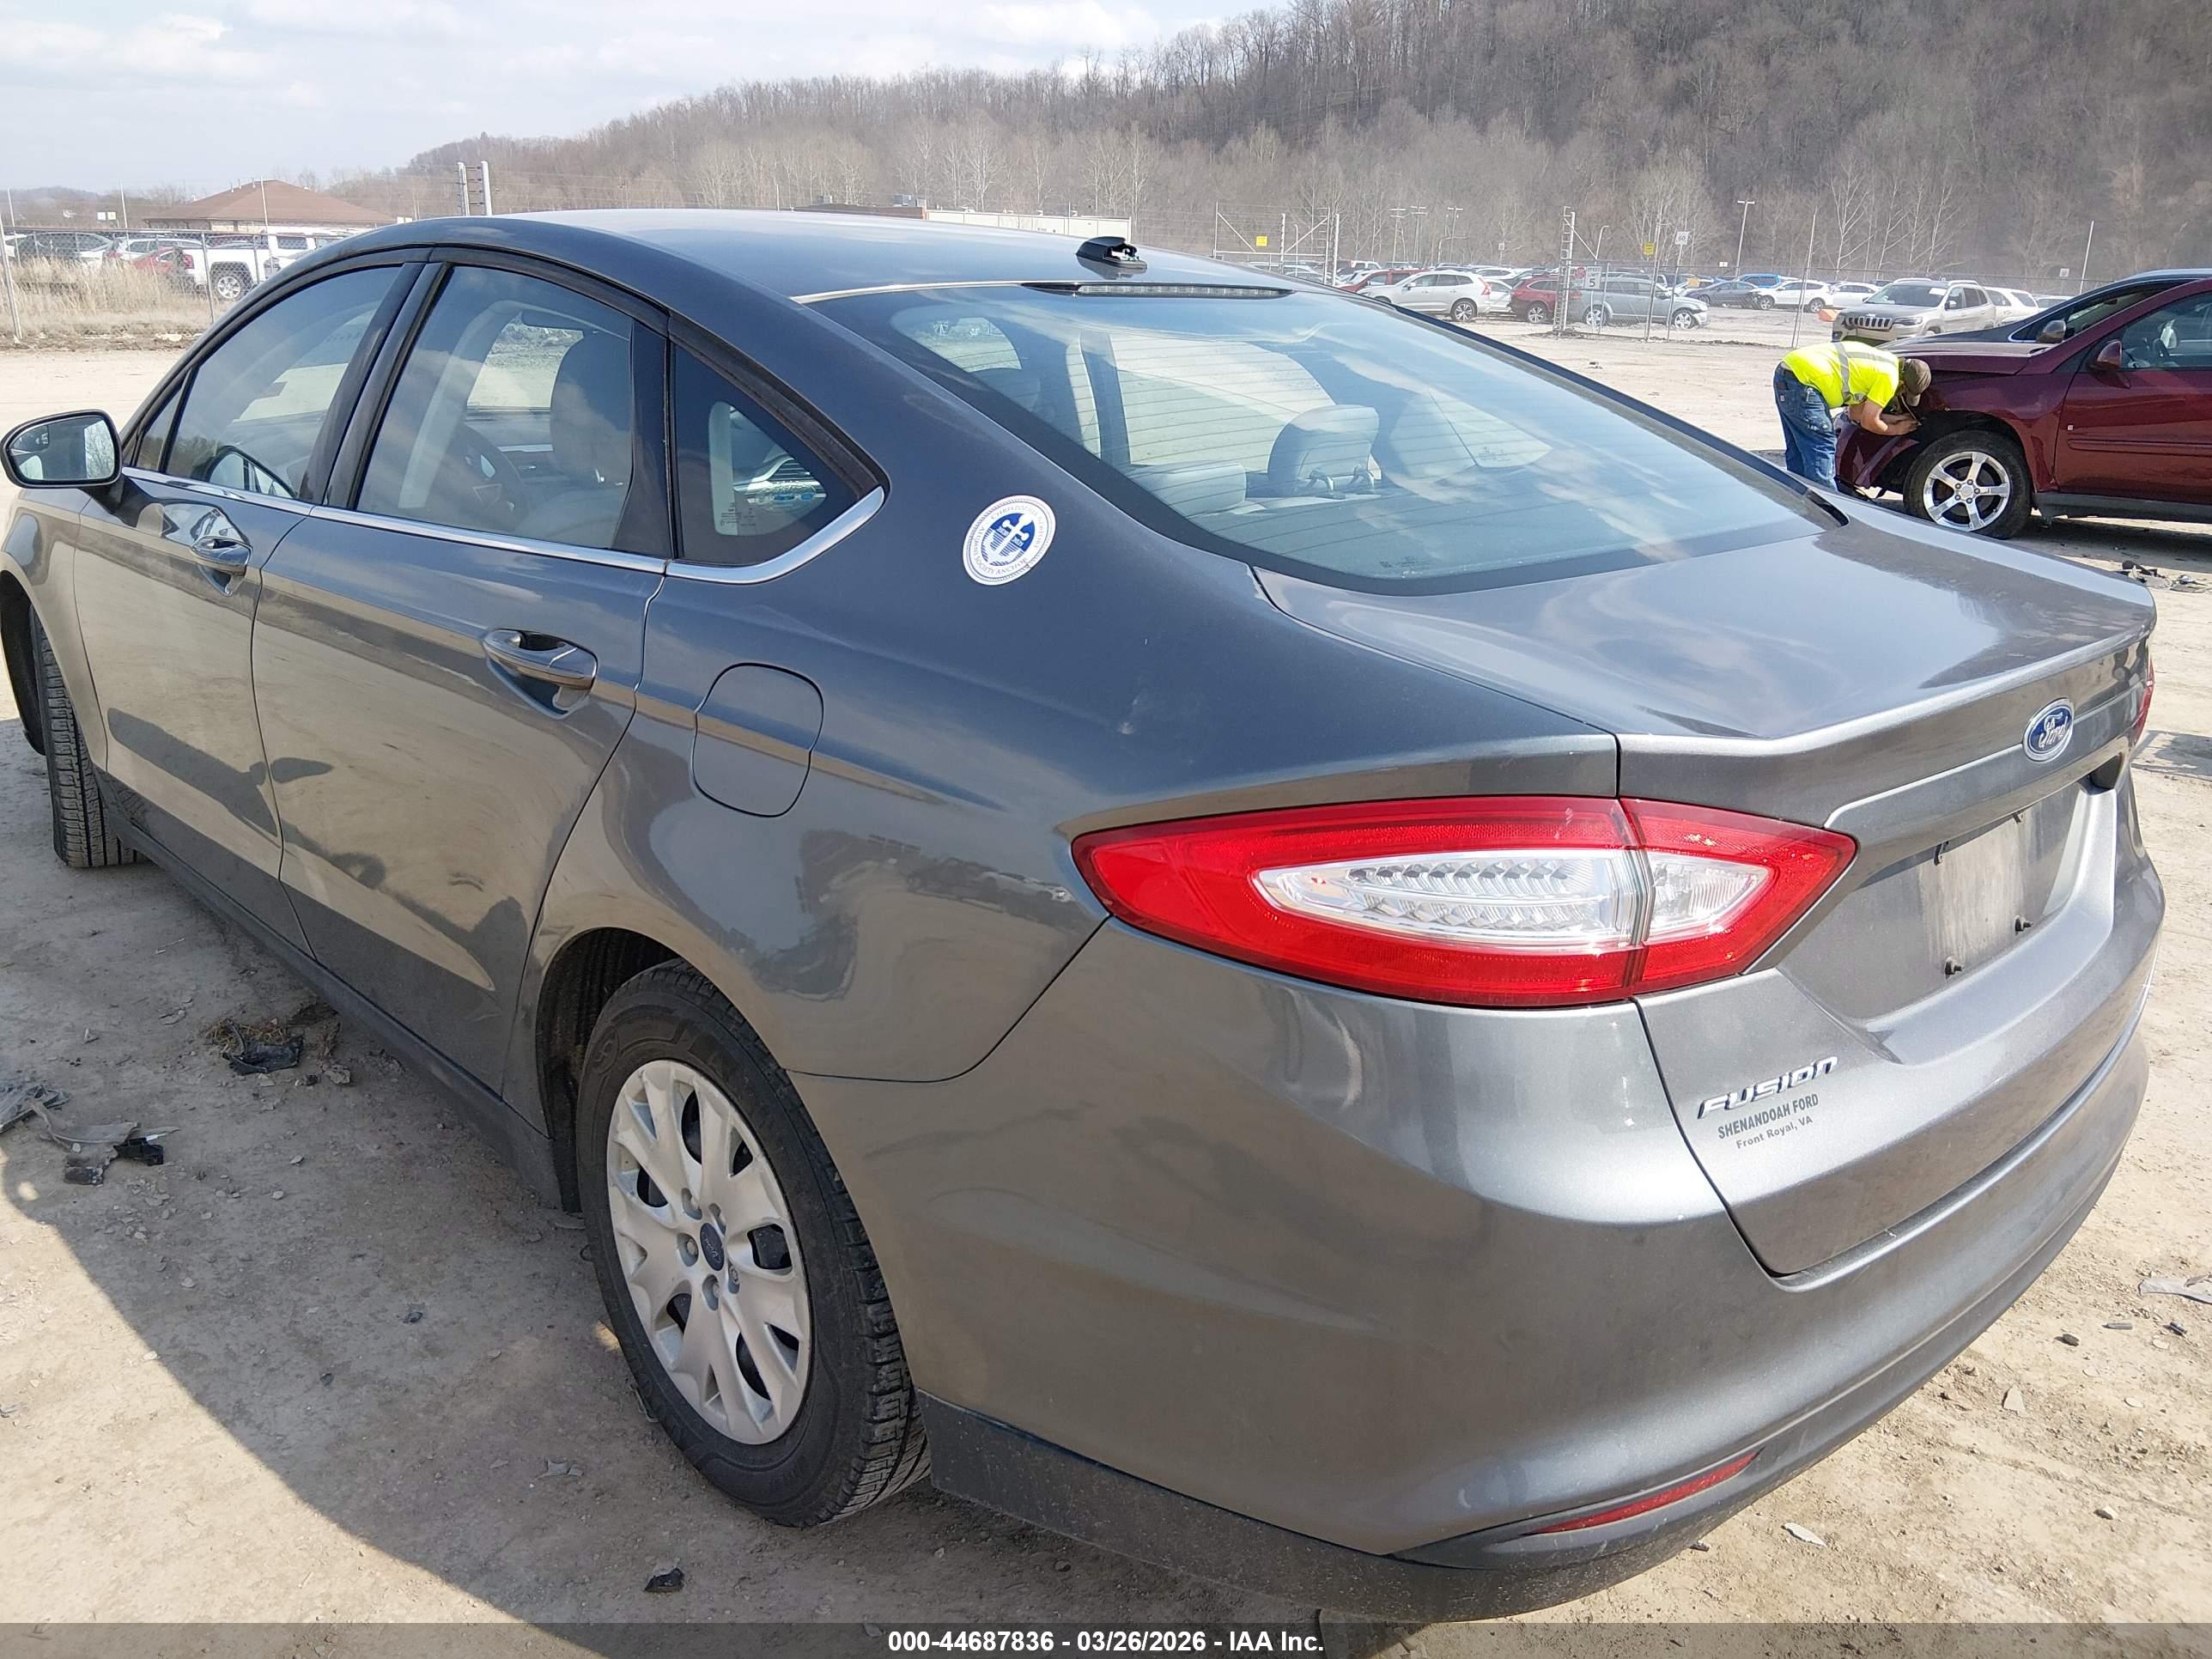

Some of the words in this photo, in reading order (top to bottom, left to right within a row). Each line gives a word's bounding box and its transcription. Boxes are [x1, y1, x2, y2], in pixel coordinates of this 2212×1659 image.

[1589, 278, 1595, 288] 5
[2038, 711, 2069, 750] Ford
[1697, 1056, 1838, 1120] FUSION
[1717, 1103, 1790, 1139] SHENANDOAH
[1793, 1093, 1819, 1114] FORD
[1735, 1133, 1765, 1149] Front
[1766, 1121, 1798, 1138] Royal,
[1798, 1115, 1814, 1128] VA
